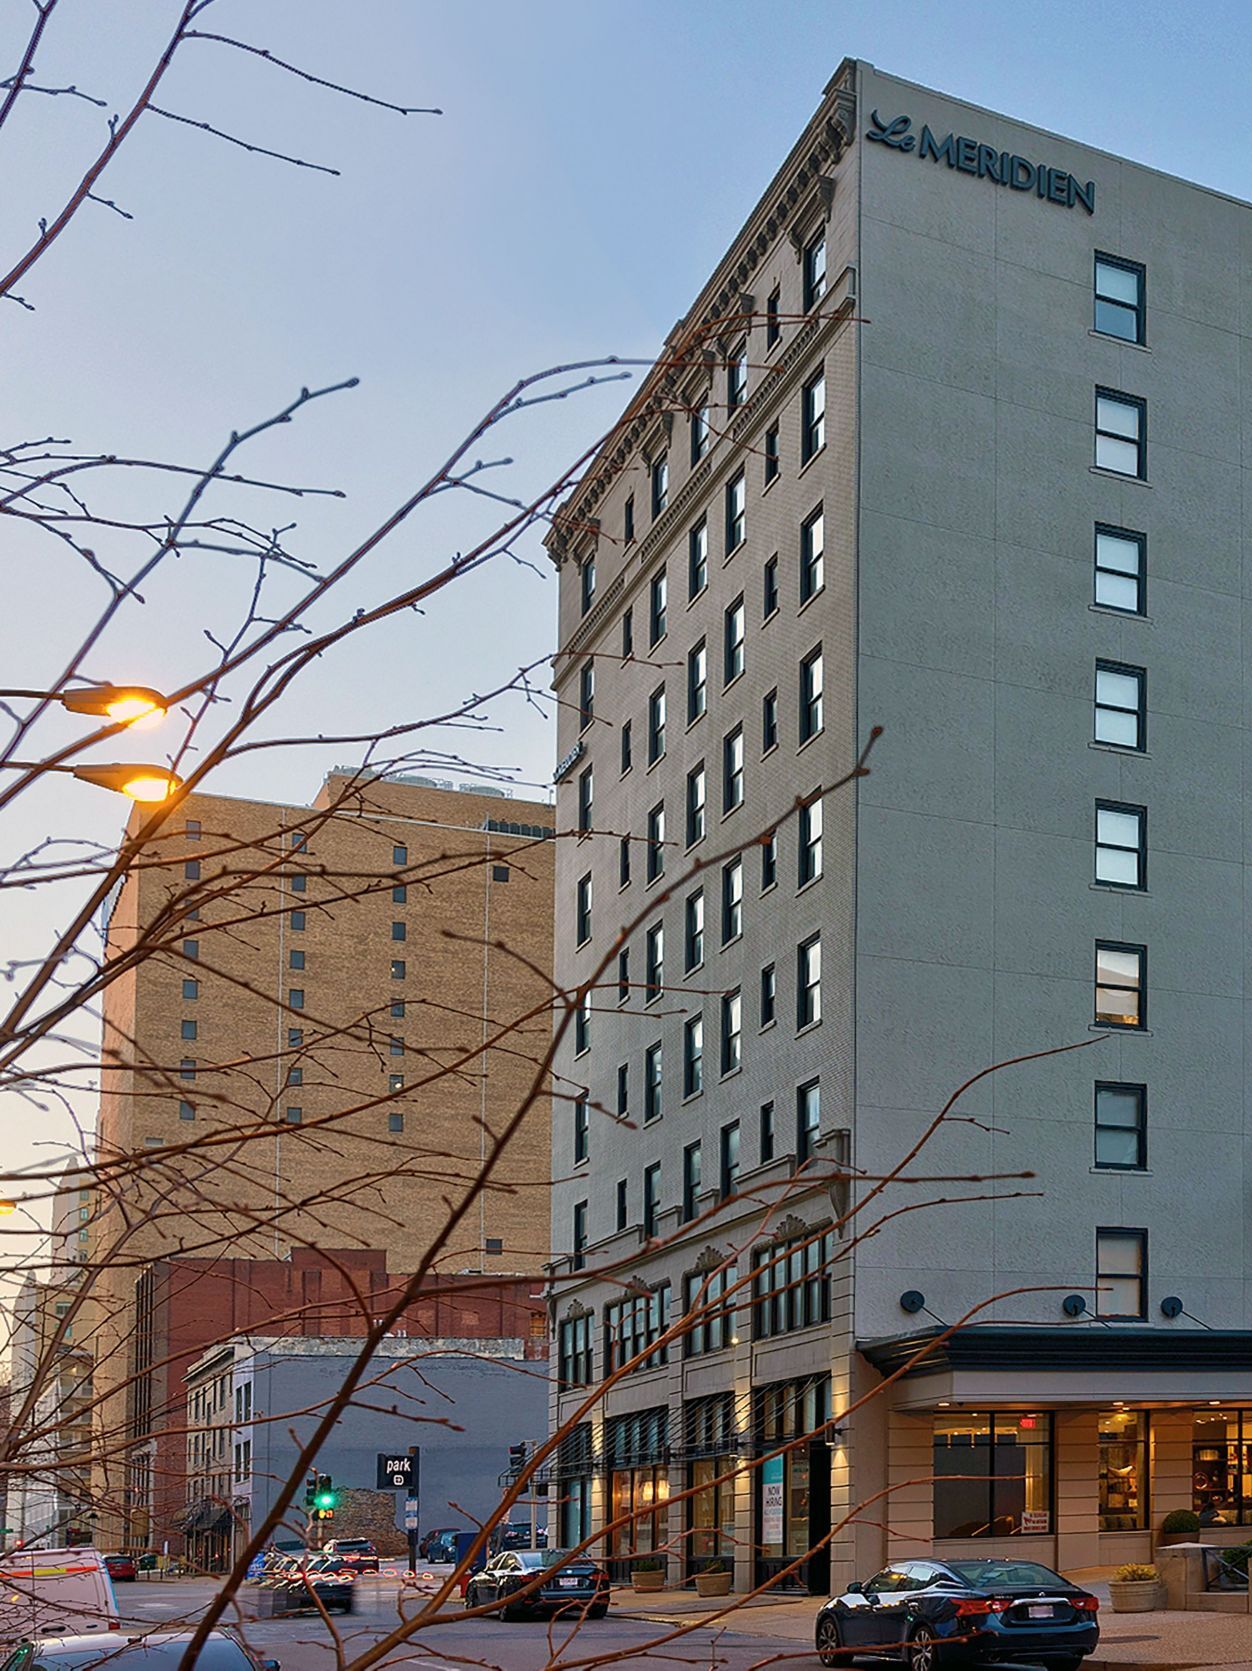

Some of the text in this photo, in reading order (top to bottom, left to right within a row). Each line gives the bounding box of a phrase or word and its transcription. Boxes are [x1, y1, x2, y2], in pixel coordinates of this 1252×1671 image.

[866, 109, 1096, 216] Le MERIDIEN
[386, 1458, 411, 1474] park
[767, 1486, 781, 1496] NOW
